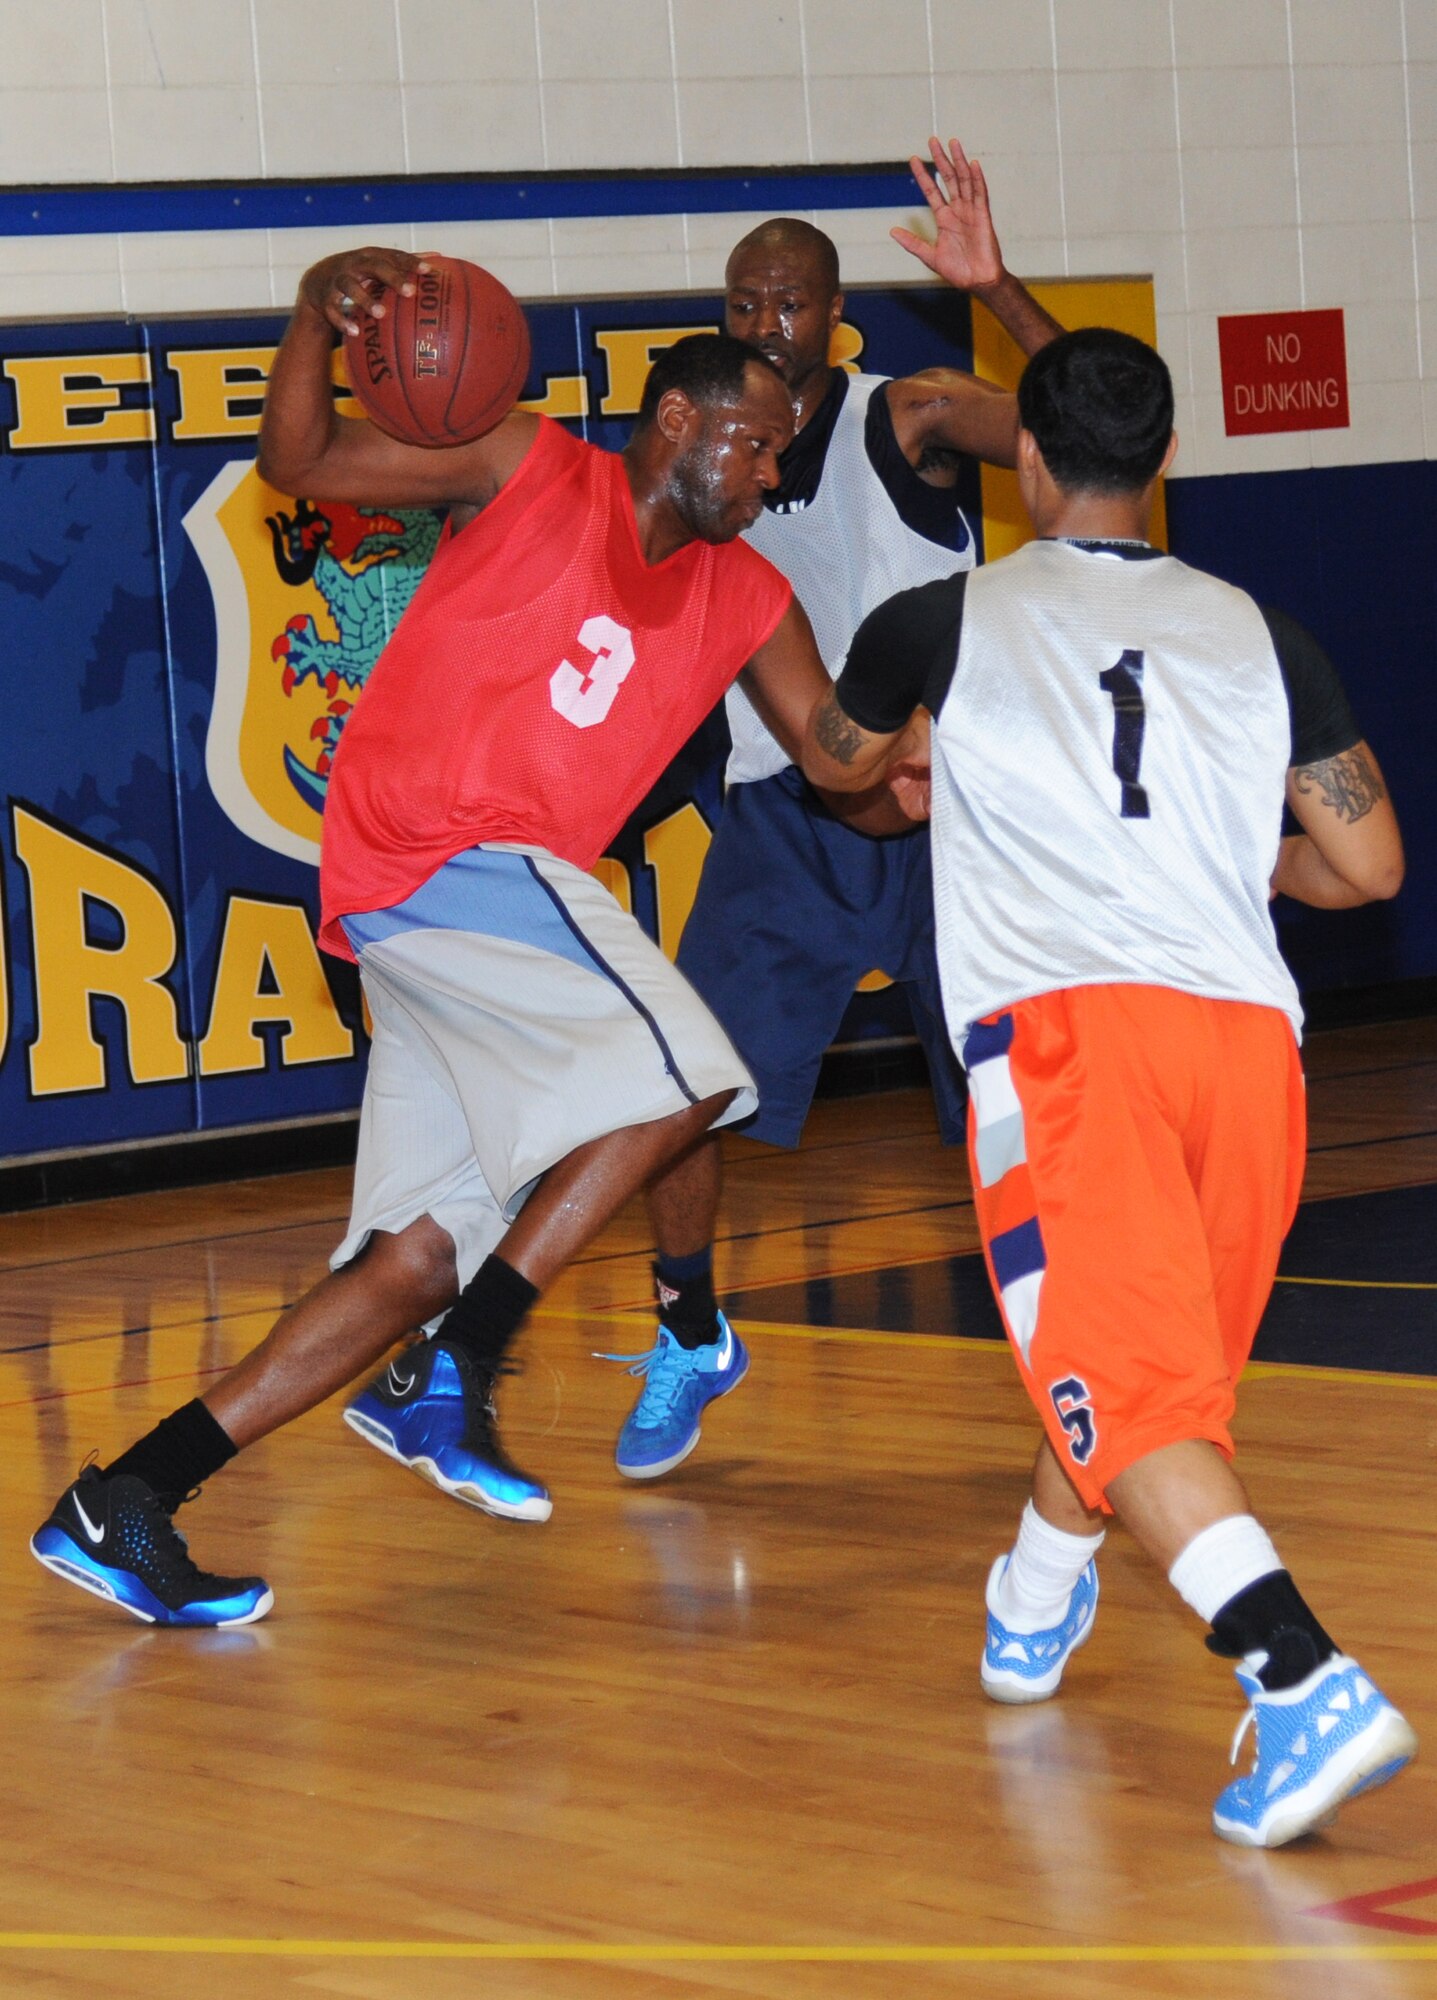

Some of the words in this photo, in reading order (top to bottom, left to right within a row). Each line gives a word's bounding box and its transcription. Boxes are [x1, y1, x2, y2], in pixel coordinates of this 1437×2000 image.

[1266, 332, 1301, 364] NO
[1234, 378, 1339, 415] DUNKING
[549, 614, 636, 729] 3
[1099, 649, 1150, 819] 1
[1048, 1375, 1097, 1466] S
